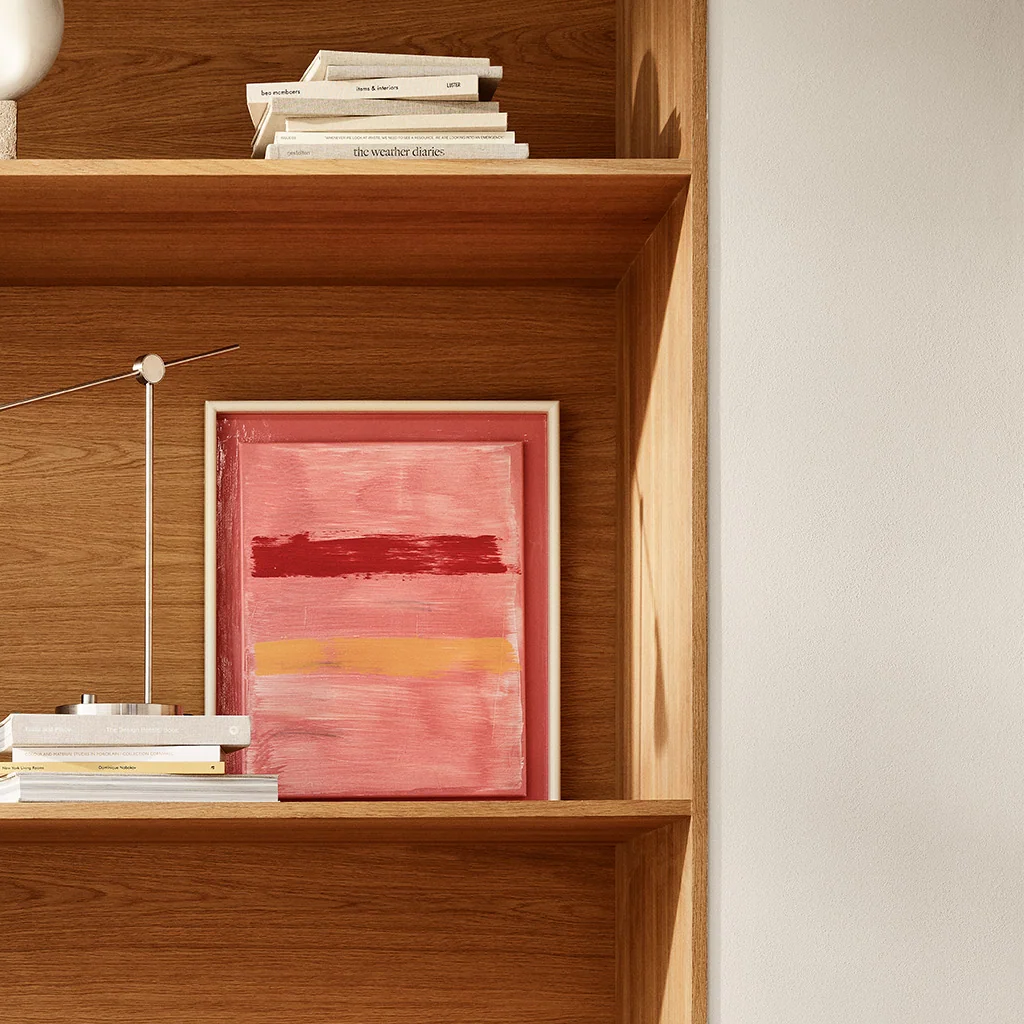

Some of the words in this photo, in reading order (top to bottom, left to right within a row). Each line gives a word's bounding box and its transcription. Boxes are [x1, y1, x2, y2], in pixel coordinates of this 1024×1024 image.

[353, 147, 369, 157] the
[371, 147, 410, 157] weather
[412, 146, 445, 157] diaries
